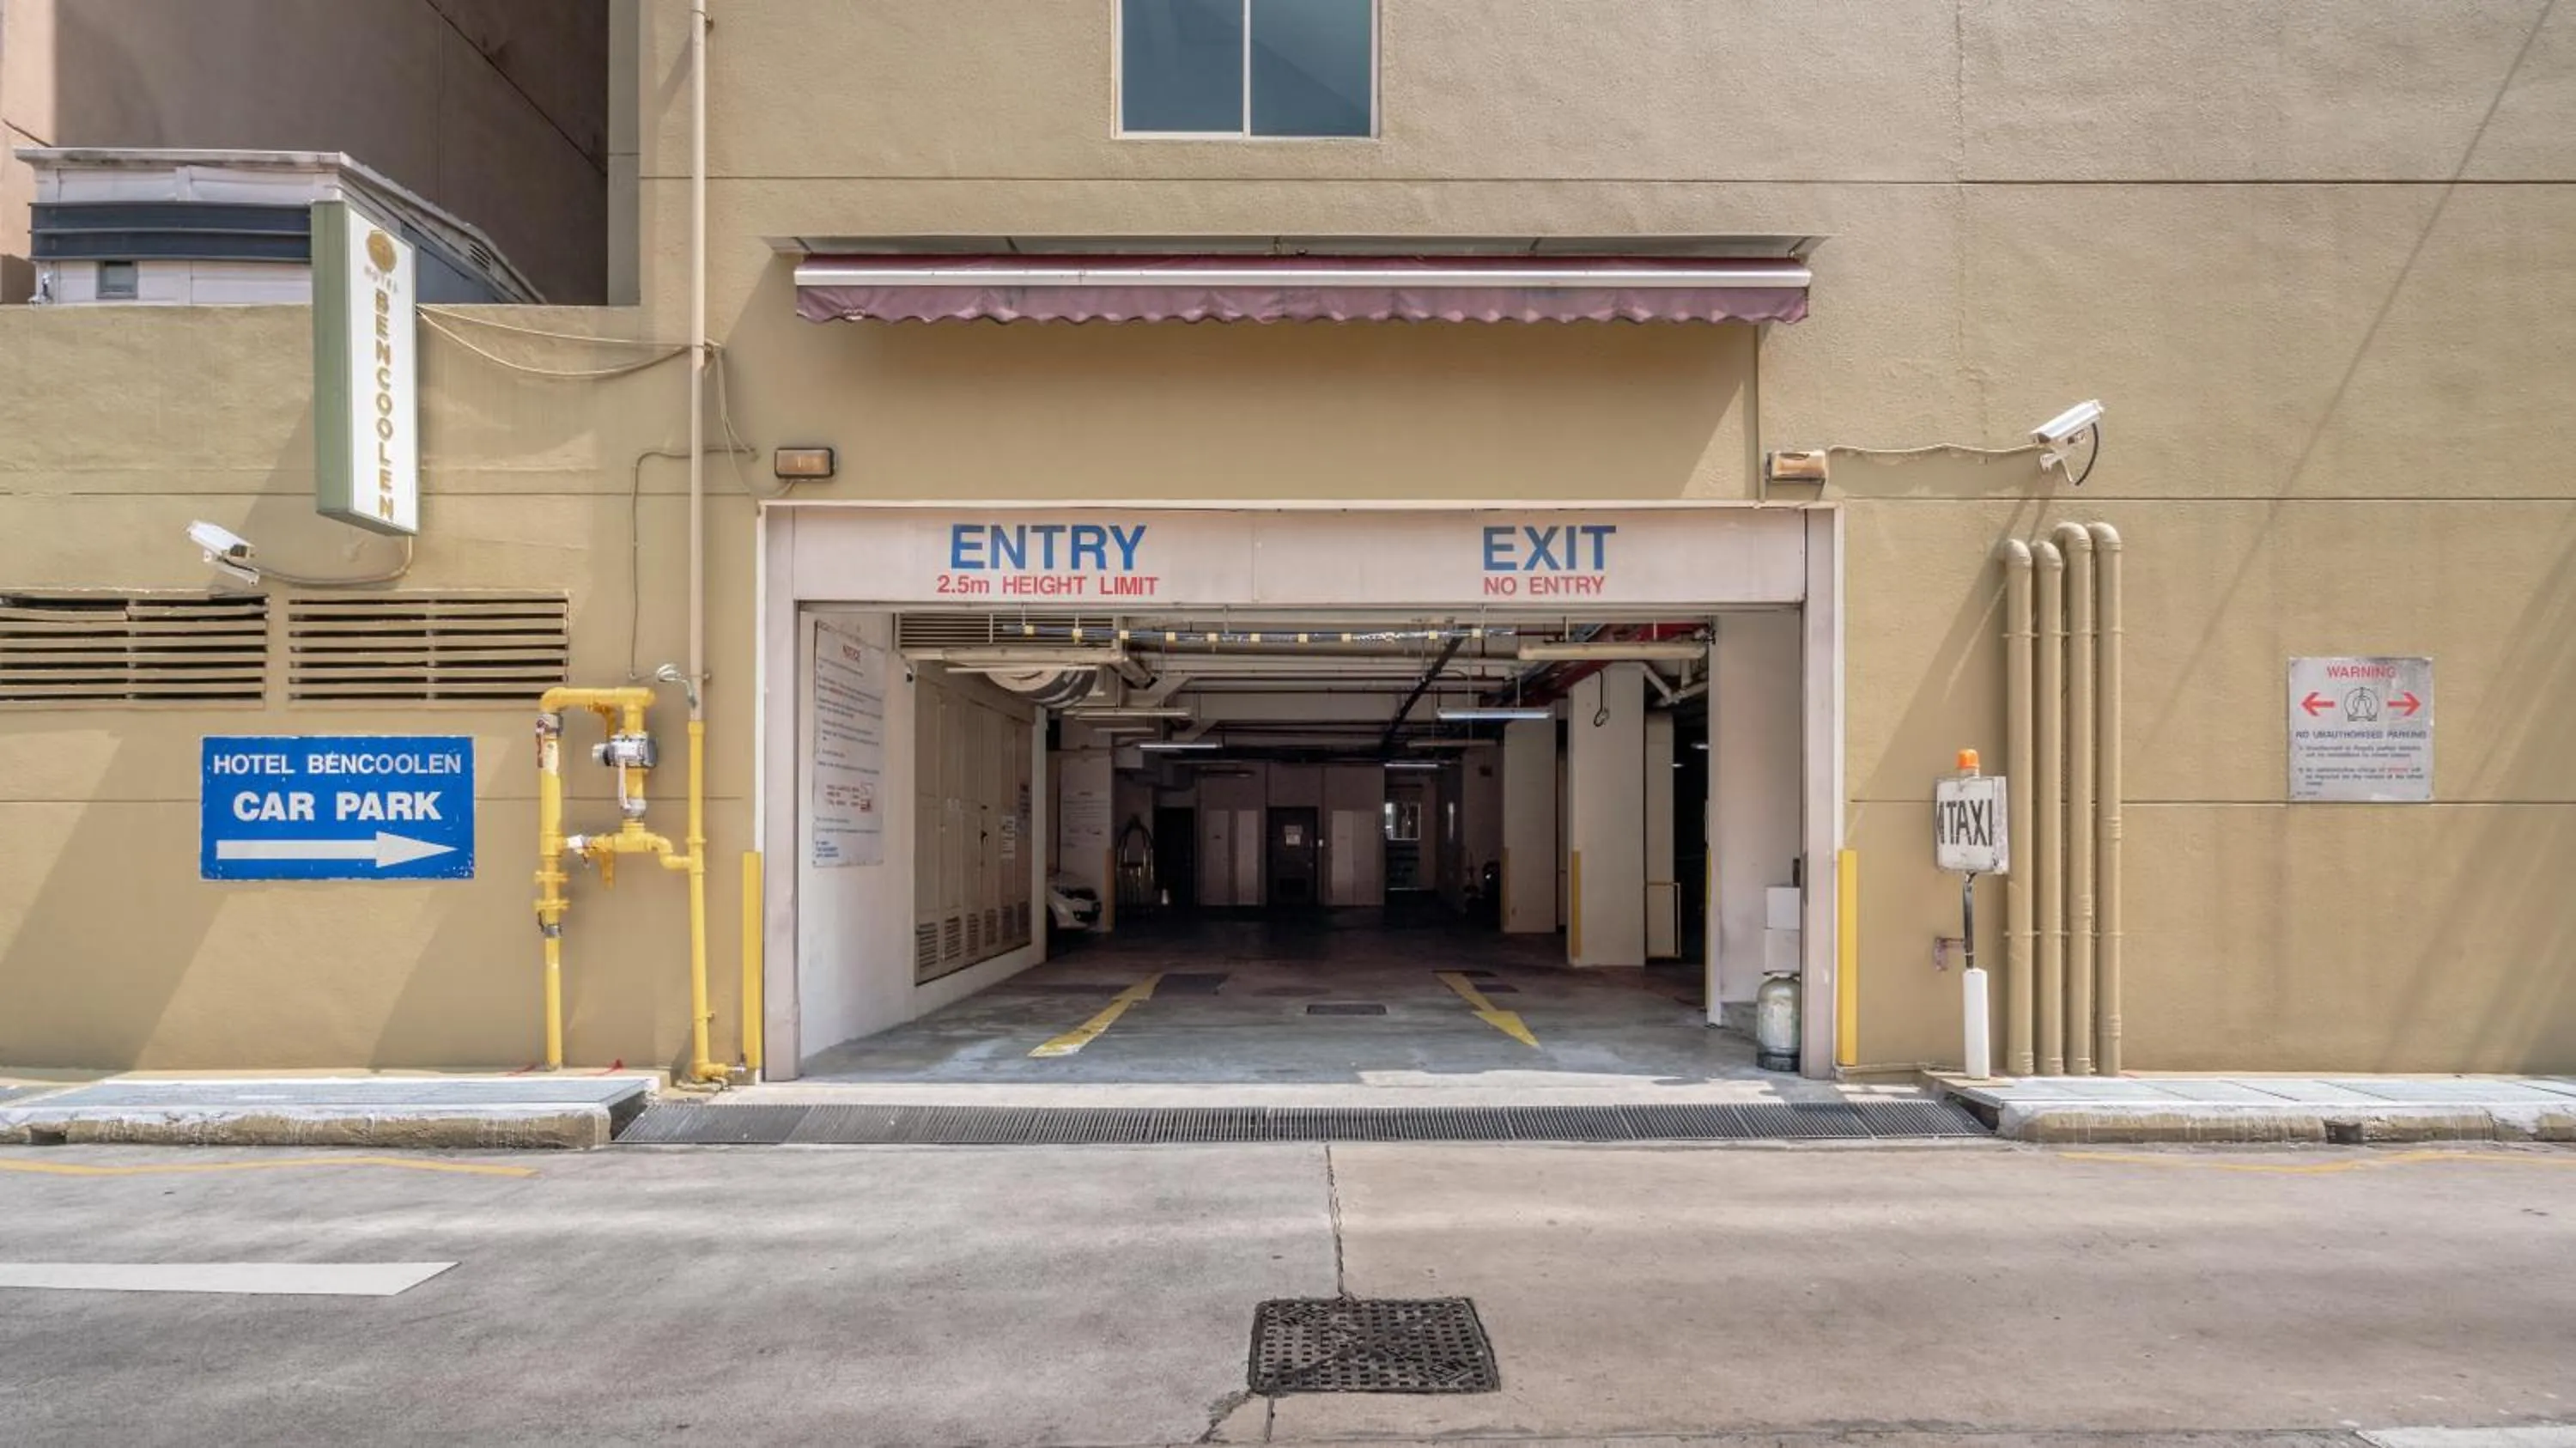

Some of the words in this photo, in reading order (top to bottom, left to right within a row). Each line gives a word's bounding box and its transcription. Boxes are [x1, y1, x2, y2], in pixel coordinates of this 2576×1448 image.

[374, 288, 393, 520] BENCOOLEN
[951, 524, 1146, 570] ENTRY
[1483, 525, 1617, 571] EXIT
[937, 575, 990, 594] 2.5m
[1002, 575, 1087, 595] HEIGHT
[1100, 576, 1159, 595] LIMIT
[1483, 576, 1517, 595] NO
[1529, 576, 1605, 595] ENTRY
[2326, 666, 2397, 678] WARNING
[2387, 731, 2427, 739] PARKING
[213, 754, 295, 775] HOTEL
[307, 754, 462, 775] BENCOOLEN
[233, 791, 315, 822] CAR
[336, 791, 442, 821] PARK
[1946, 800, 1993, 846] TAXI
